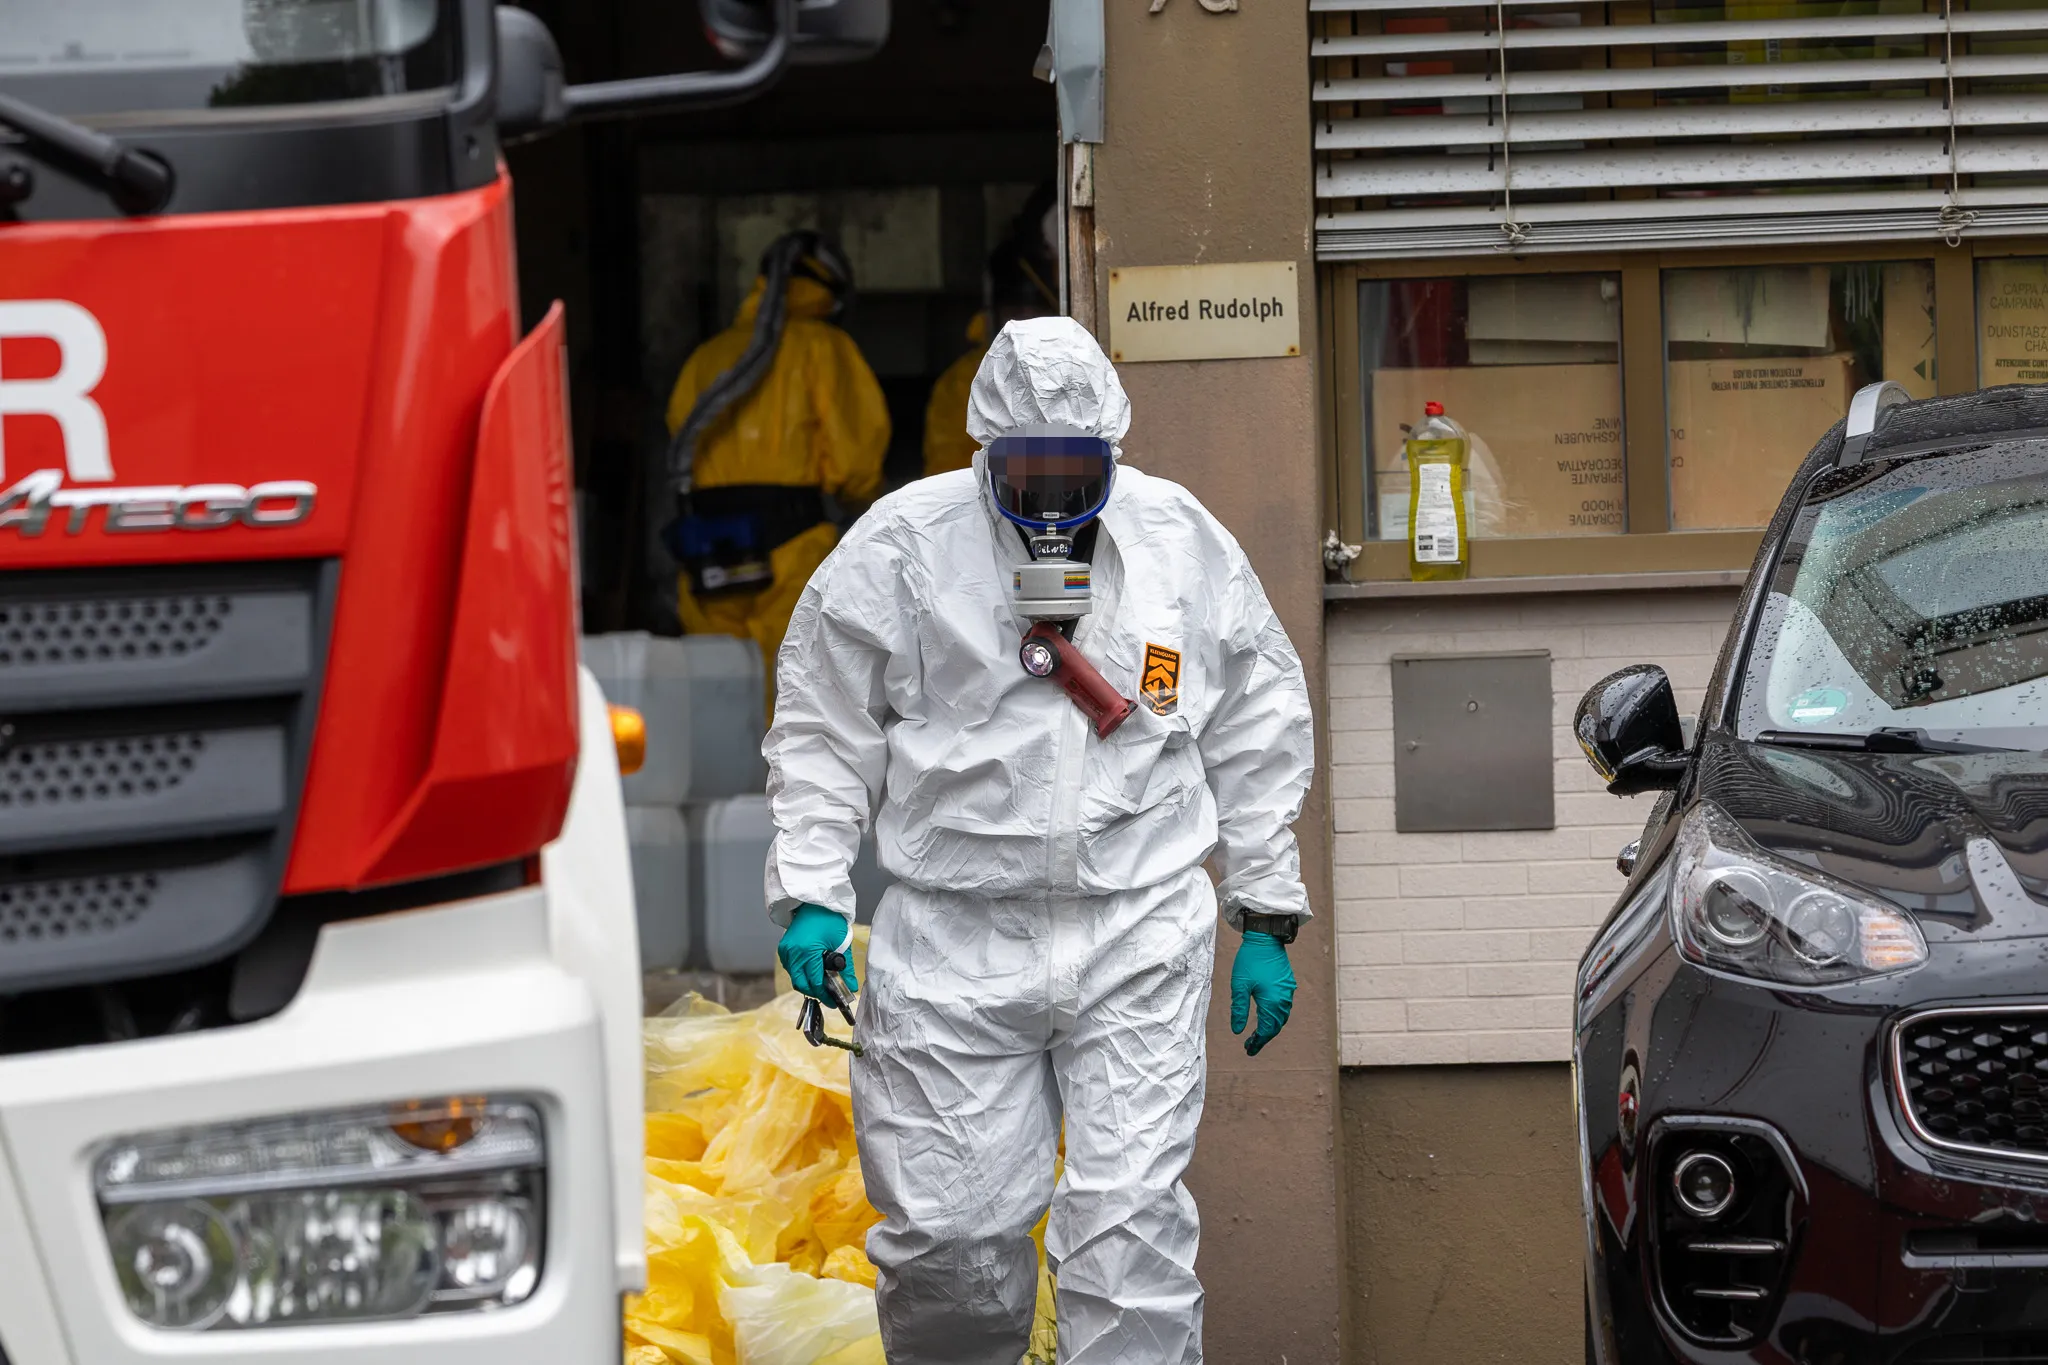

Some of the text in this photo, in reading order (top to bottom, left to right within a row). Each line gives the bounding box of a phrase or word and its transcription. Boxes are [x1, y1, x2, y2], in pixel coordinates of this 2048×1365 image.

[2003, 283, 2038, 295] CAPPA
[1990, 297, 2045, 309] CAMPANA
[1127, 297, 1283, 322] Alfred Rudolph
[1988, 325, 2047, 338] DUNSTABZ
[0, 299, 116, 484] R
[1582, 500, 1614, 511] HOOD
[1569, 513, 1623, 525] CORATIVE
